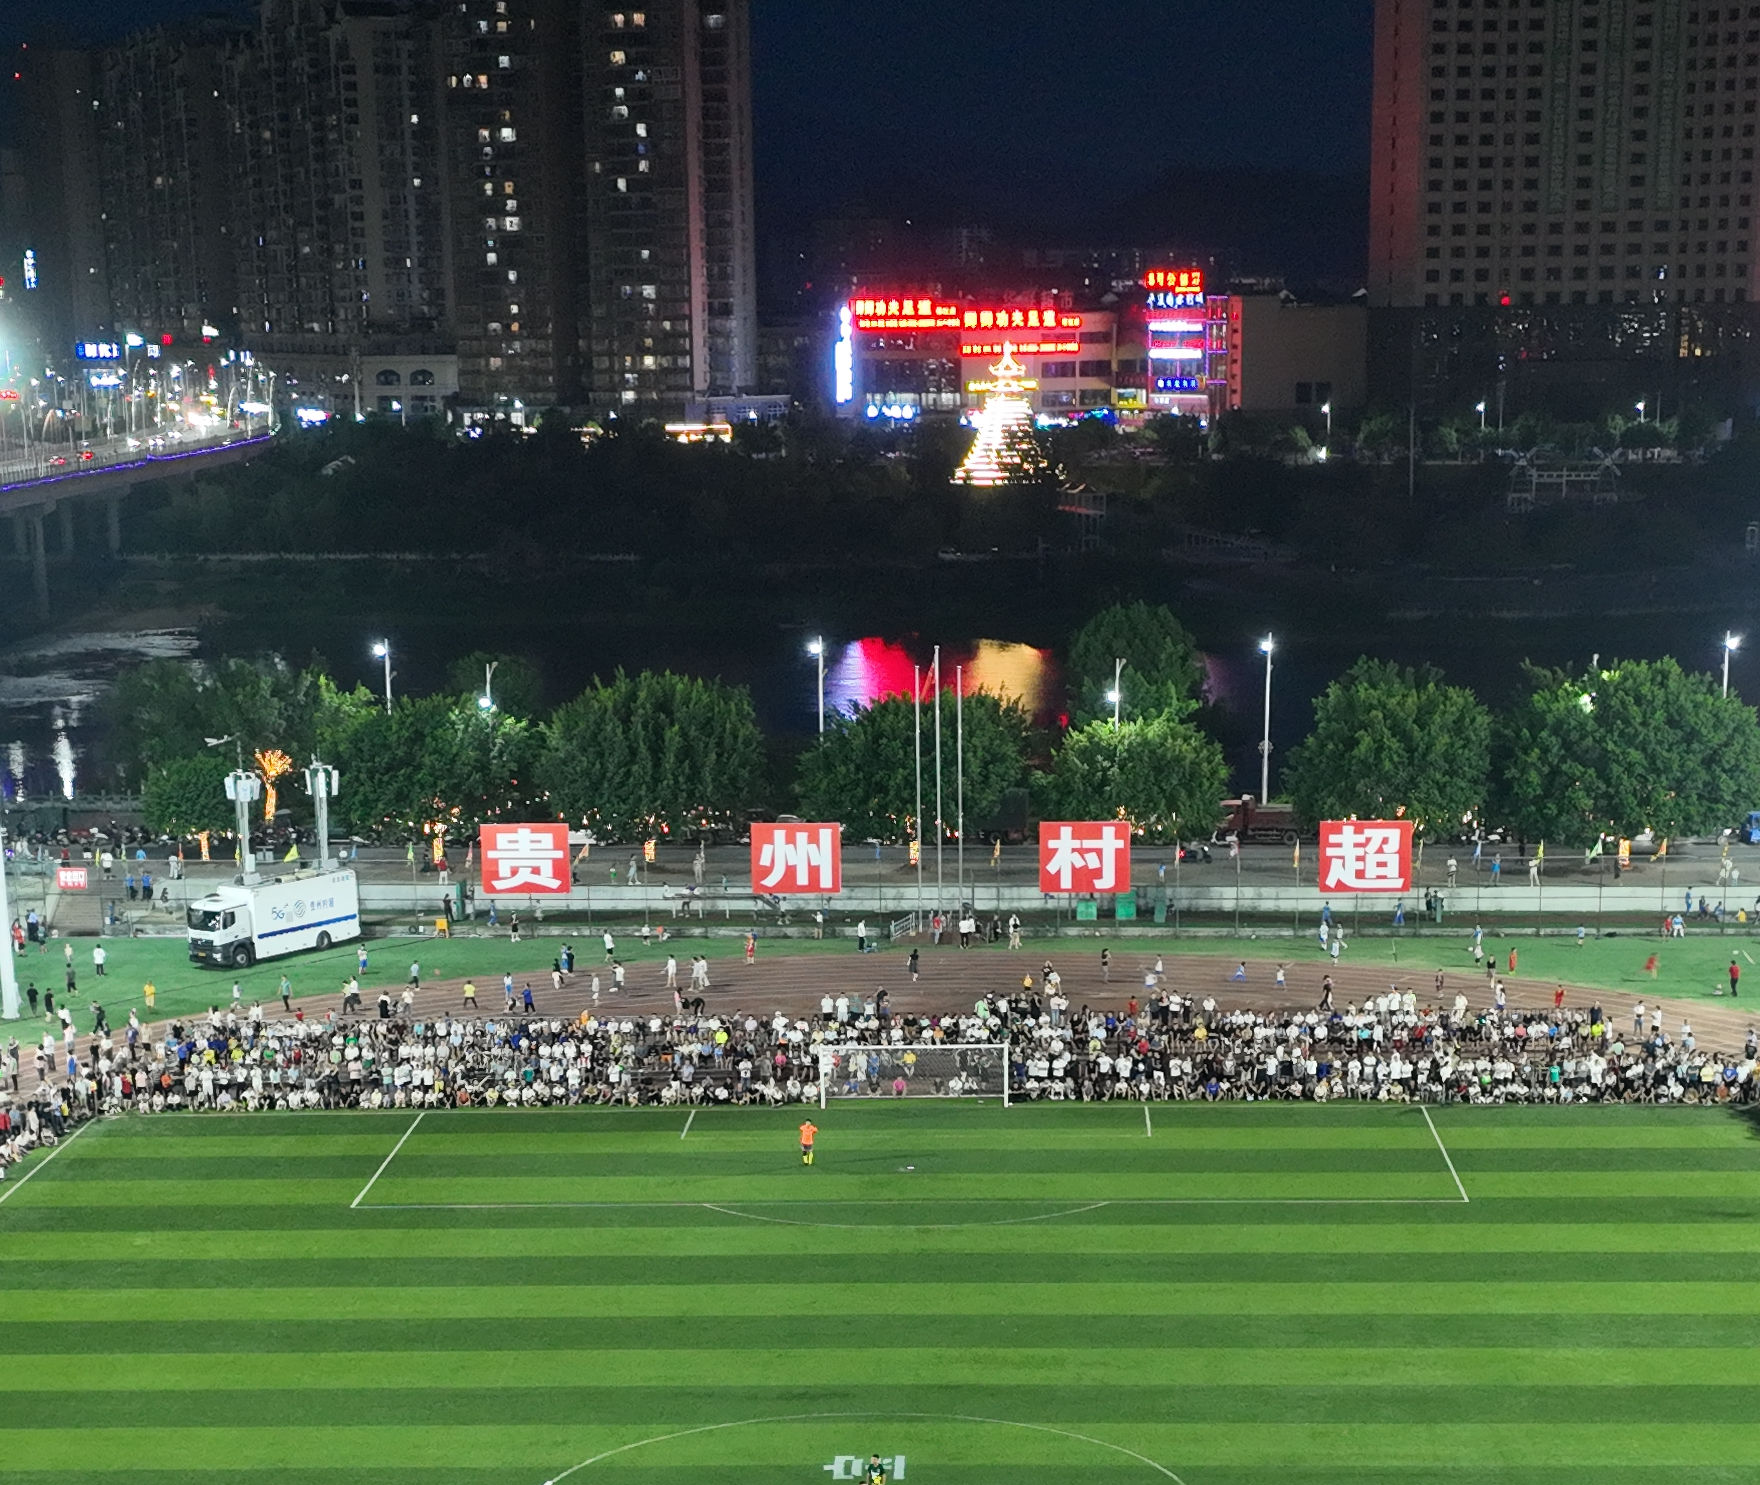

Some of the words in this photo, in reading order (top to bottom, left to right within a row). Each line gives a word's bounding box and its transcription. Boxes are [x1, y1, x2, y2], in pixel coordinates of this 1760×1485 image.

[486, 827, 564, 889] 贵
[759, 828, 834, 889] 州
[1046, 826, 1125, 889] 村
[1326, 825, 1404, 889] 超
